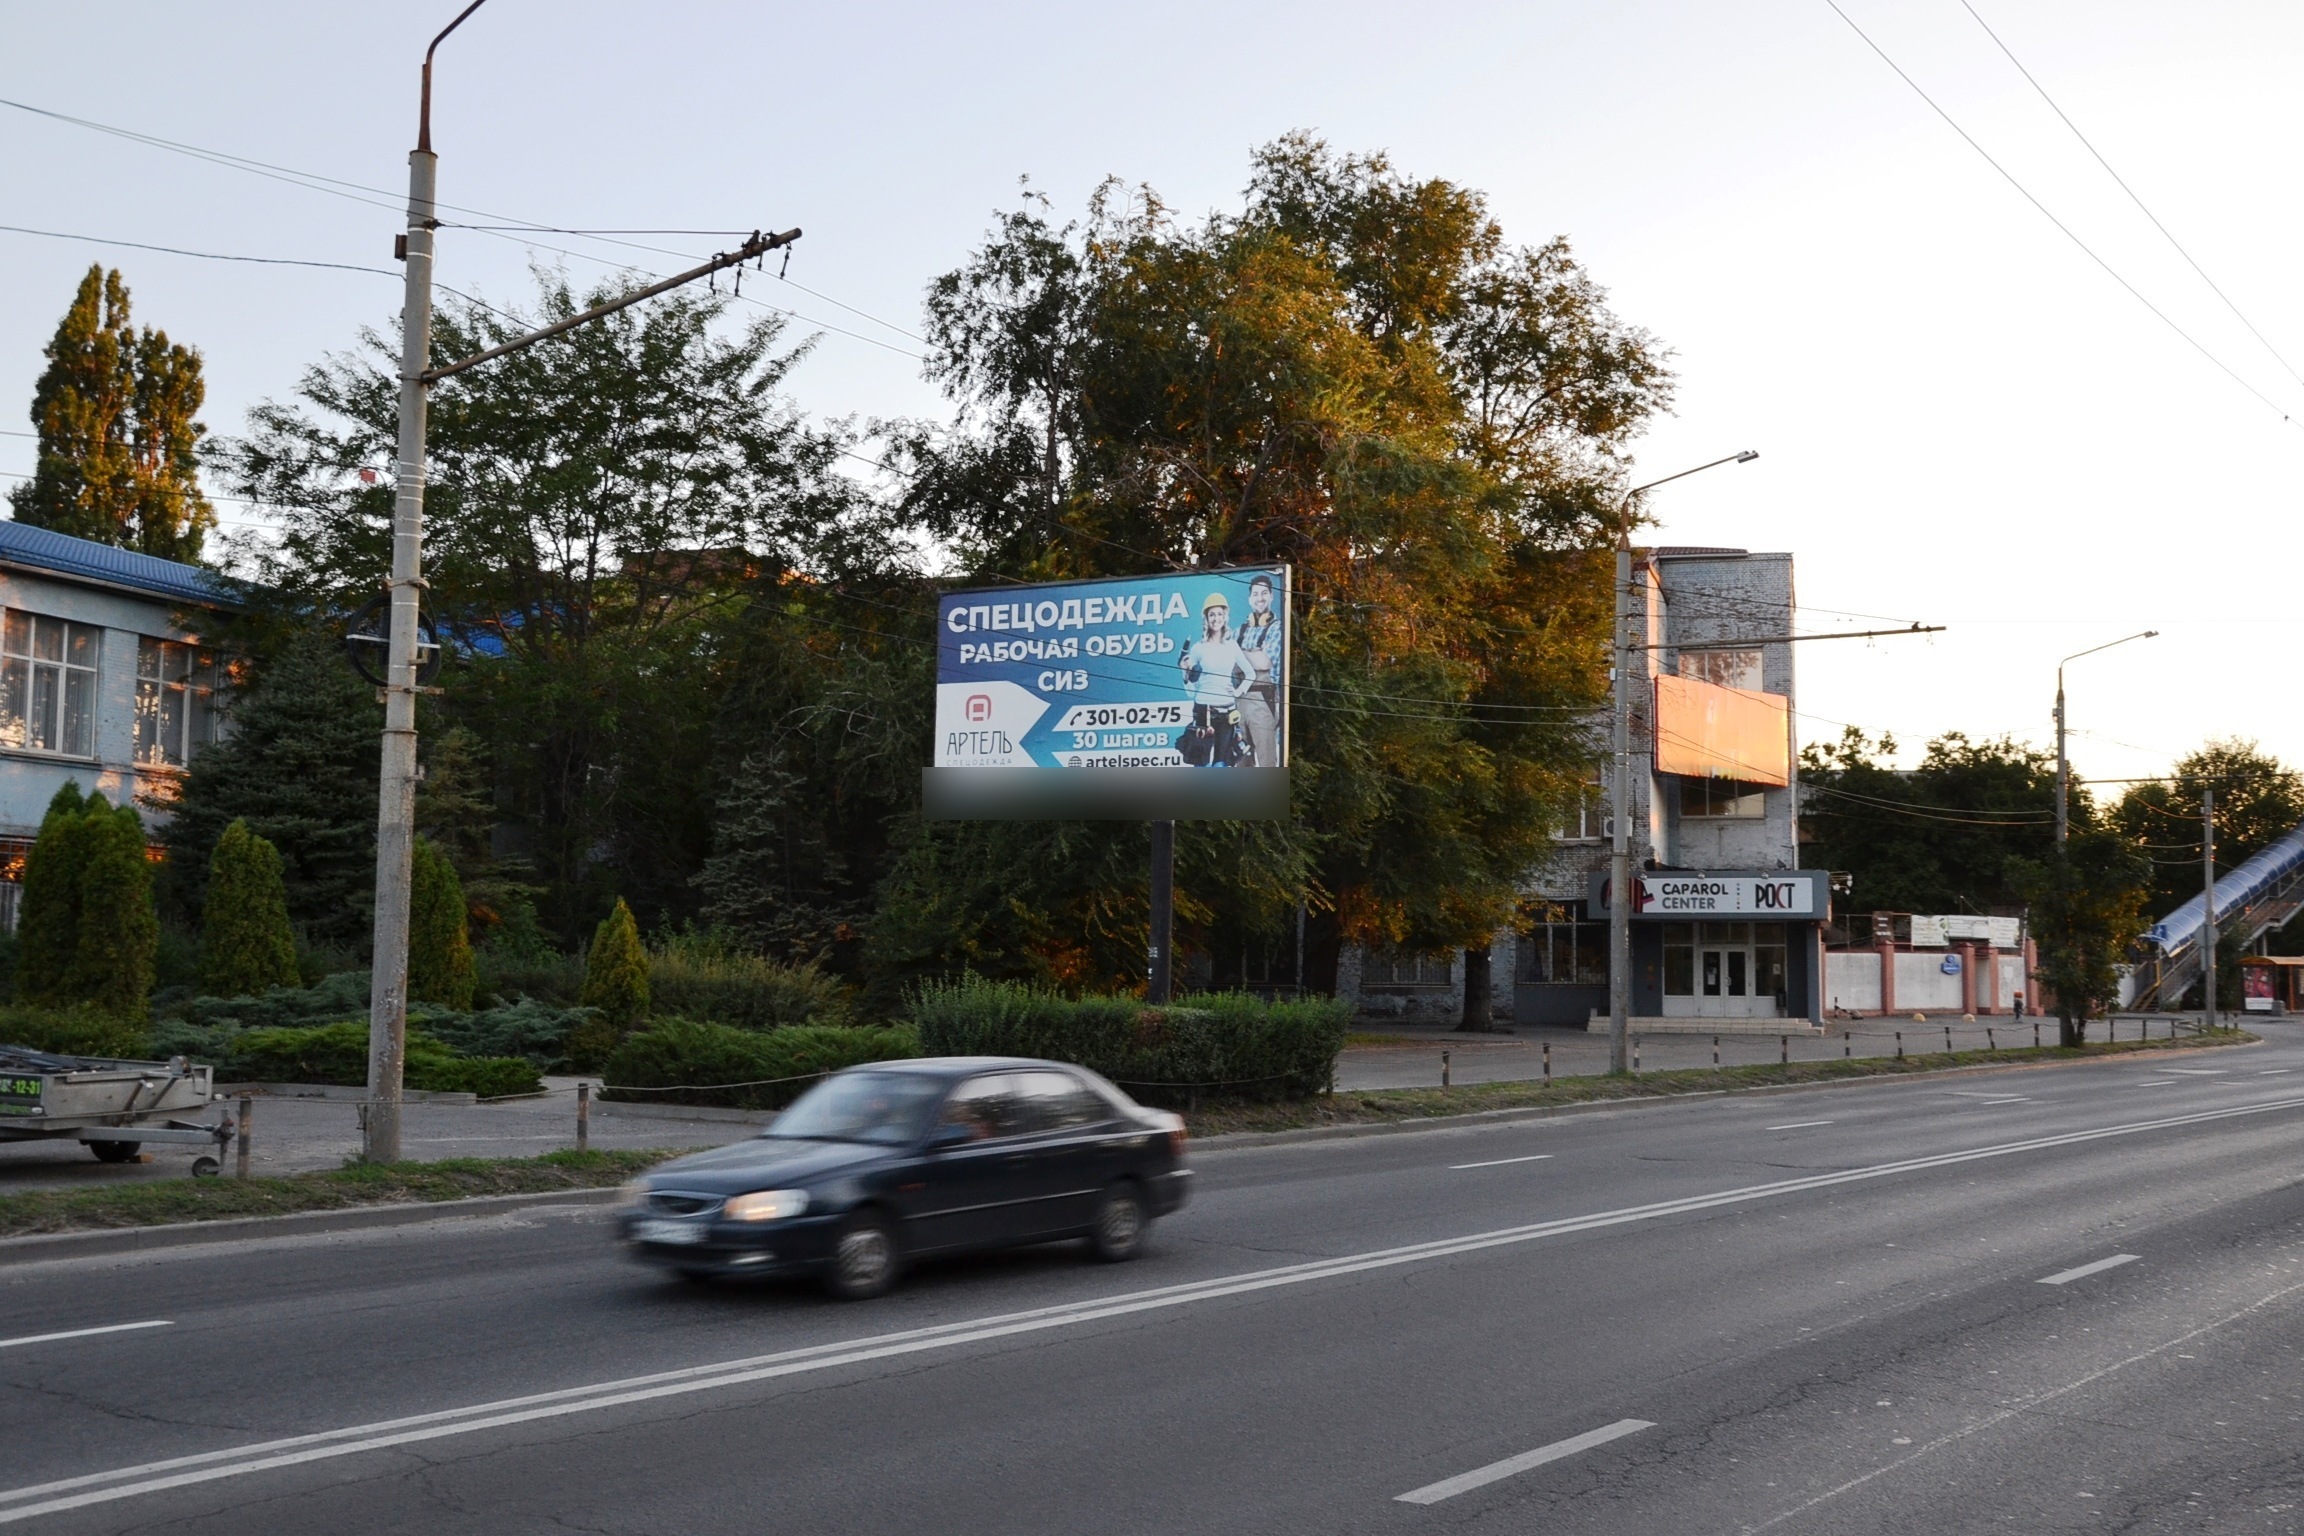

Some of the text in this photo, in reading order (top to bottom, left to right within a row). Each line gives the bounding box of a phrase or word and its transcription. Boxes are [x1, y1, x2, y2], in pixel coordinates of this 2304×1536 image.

[947, 592, 1190, 634] СПЕЦОДЕЖДА
[959, 632, 1175, 665] РАБОЧАЯ ОБУВЬ
[1037, 669, 1090, 693] СИЗ
[1086, 706, 1182, 727] 301-02-75
[946, 731, 1013, 756] АРТЕЛЬ
[1072, 731, 1169, 750] 30 шагов
[946, 757, 1013, 768] СПЕЦОДЕЖДА
[1085, 753, 1182, 768] artelspec.ru
[1661, 882, 1729, 896] CAPAROL
[1661, 897, 1716, 910] CENTER
